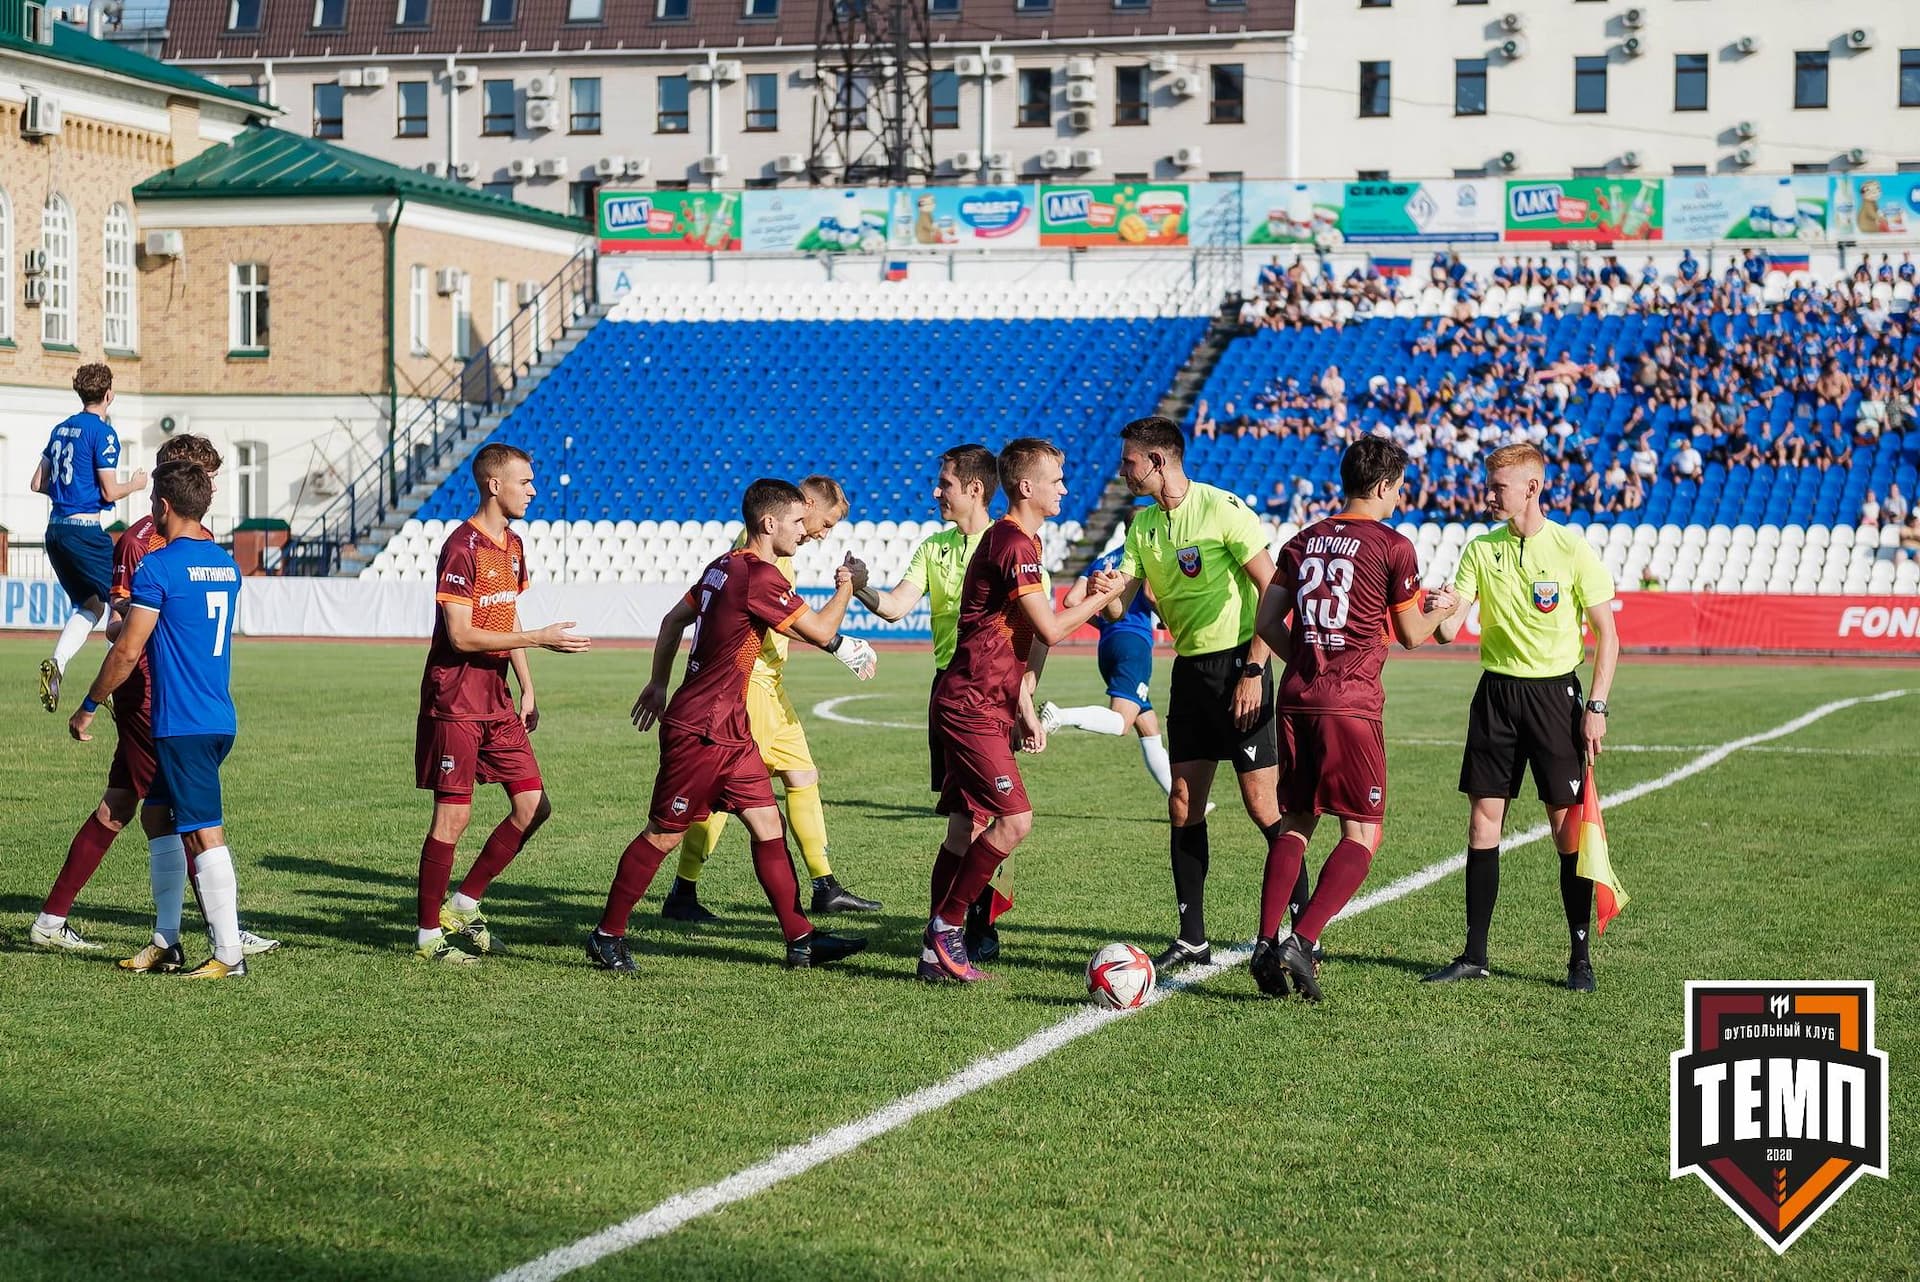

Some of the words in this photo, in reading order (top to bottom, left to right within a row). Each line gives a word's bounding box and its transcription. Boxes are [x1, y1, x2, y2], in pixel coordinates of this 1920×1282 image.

[1306, 536, 1361, 557] ВОРОНА
[445, 573, 466, 586] ПСБ
[1297, 557, 1354, 629] 23
[206, 591, 229, 657] 7
